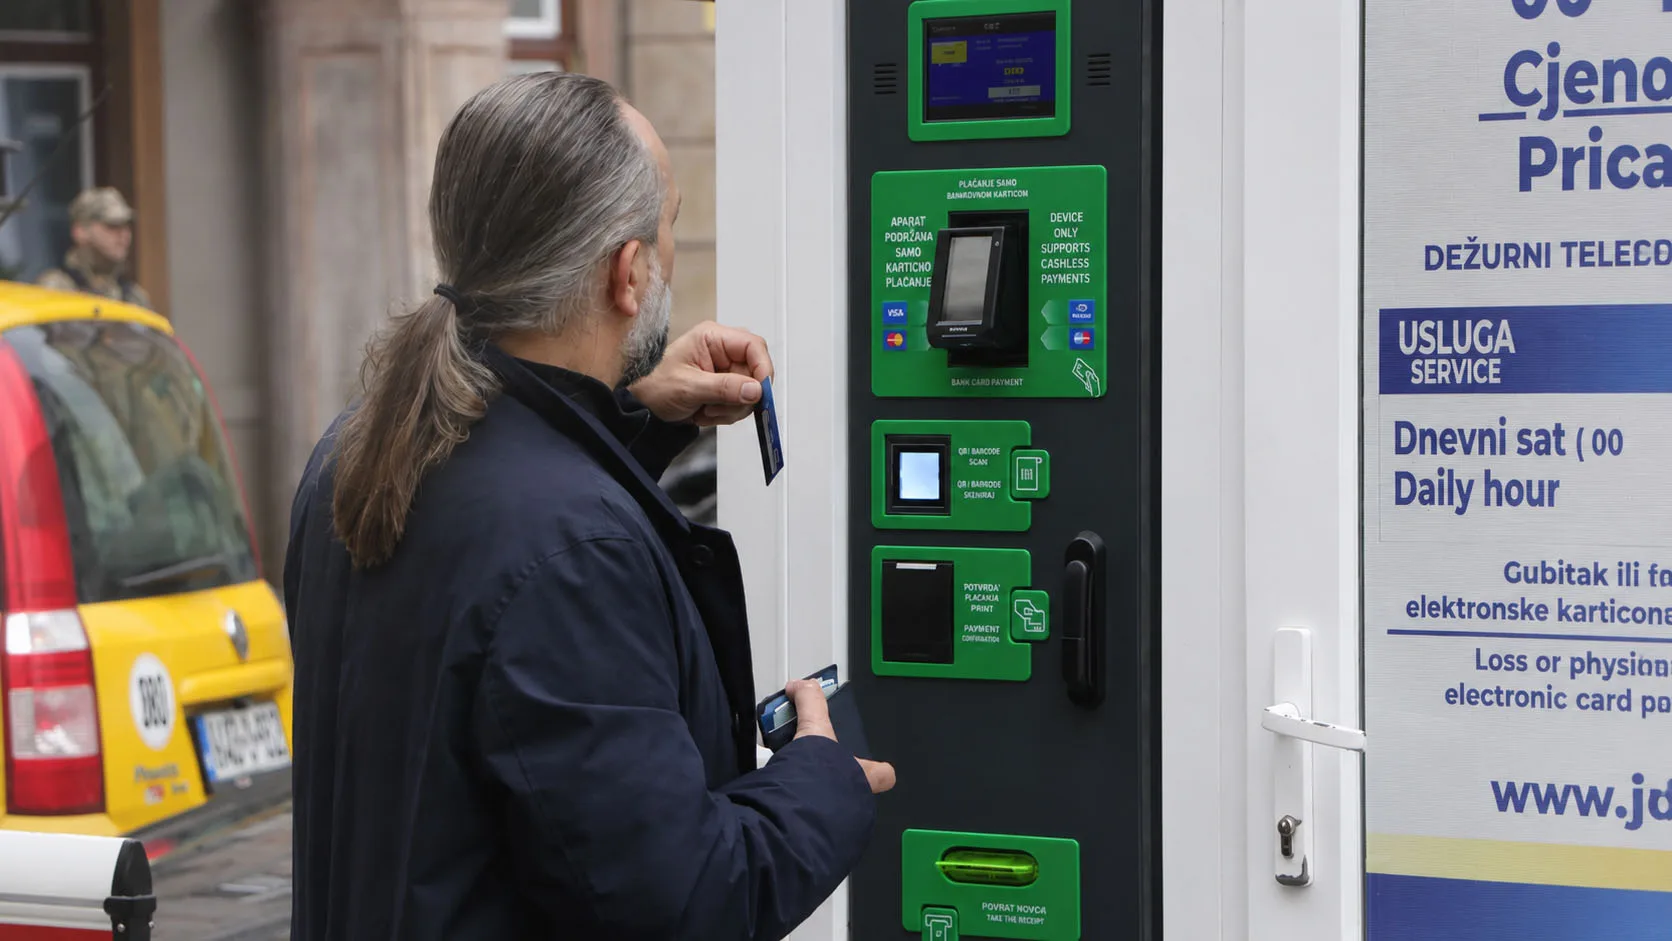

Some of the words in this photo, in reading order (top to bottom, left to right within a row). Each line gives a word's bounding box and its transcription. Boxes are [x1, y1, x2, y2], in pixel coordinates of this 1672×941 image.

[997, 178, 1018, 188] SAMO
[994, 190, 1028, 198] KARTICOM
[891, 216, 926, 228] APARAT
[1051, 212, 1084, 222] DEVICE
[1054, 228, 1078, 238] ONLY
[896, 246, 922, 258] SAMO
[1042, 242, 1090, 254] SUPPORTS
[1425, 236, 1550, 271] DEŽURNI
[1041, 258, 1090, 268] CASHLESS
[1042, 272, 1090, 284] PAYMENTS
[1399, 319, 1515, 354] USLUGA
[1411, 359, 1500, 384] SERVICE
[992, 378, 1024, 386] PAYMENT
[1395, 416, 1506, 455] Dnevni
[1517, 423, 1566, 456] sat
[969, 458, 988, 466] SCAN
[1395, 467, 1474, 515] Daily
[1484, 469, 1560, 507] hour
[1504, 559, 1608, 586] Gubitak
[1618, 561, 1639, 587] ili
[971, 604, 994, 612] PRINT
[1406, 595, 1548, 621] elektronske
[964, 624, 1000, 634] PAYMENT
[1476, 648, 1527, 671] Loss
[1536, 656, 1561, 672] or
[1445, 682, 1567, 709] electronic
[1576, 688, 1631, 711] card
[982, 902, 1014, 912] POVRAT
[1017, 904, 1046, 914] NOVCA
